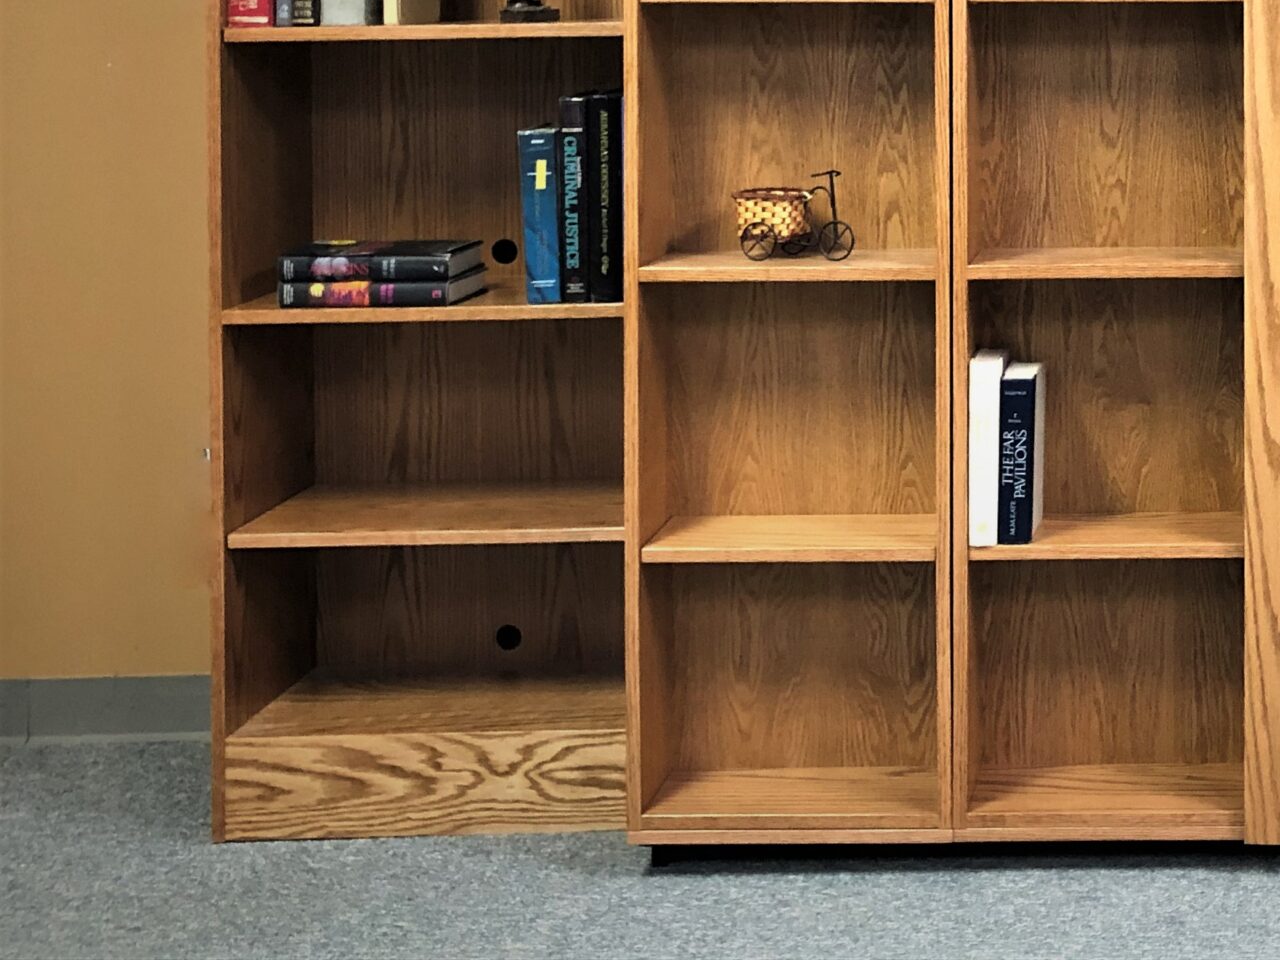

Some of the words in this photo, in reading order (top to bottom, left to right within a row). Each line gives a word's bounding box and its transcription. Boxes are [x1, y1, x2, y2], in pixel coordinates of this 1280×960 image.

[563, 136, 579, 208] CRIMINAL
[566, 210, 580, 270] JUSTICE
[1002, 431, 1015, 455] FAR
[1002, 457, 1014, 486] THE
[1013, 428, 1028, 499] PAVILIONS
